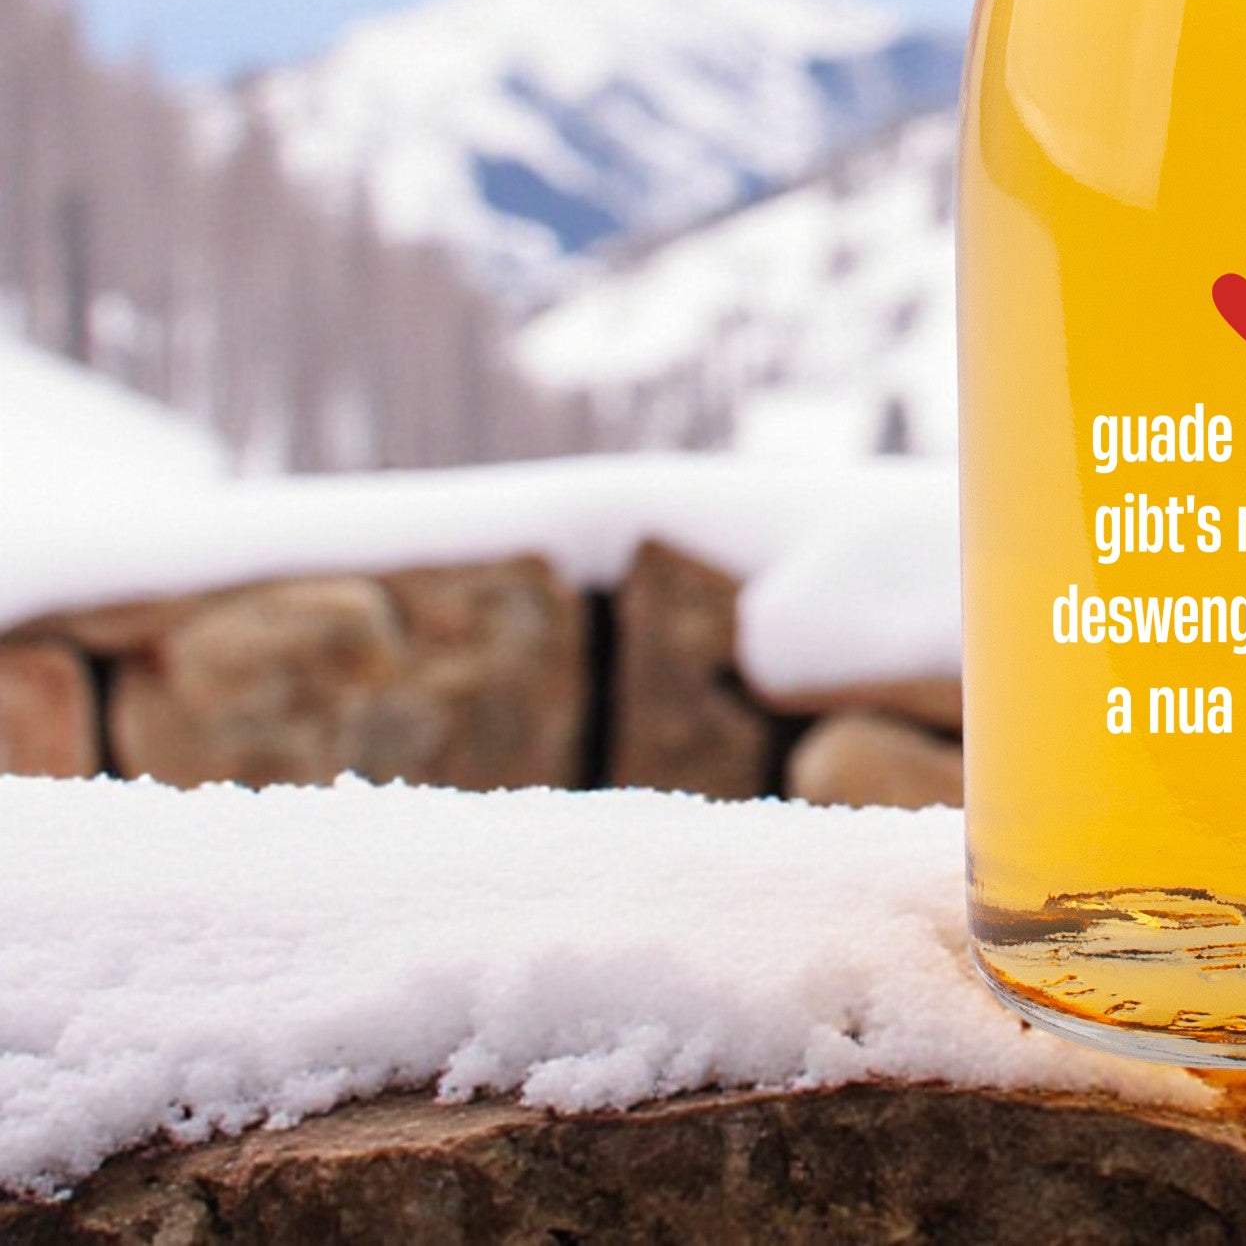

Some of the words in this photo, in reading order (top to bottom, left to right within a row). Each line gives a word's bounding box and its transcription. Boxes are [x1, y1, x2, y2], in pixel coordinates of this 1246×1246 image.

[1092, 403, 1232, 474] guade
[1094, 493, 1221, 564] gibt's
[1106, 687, 1132, 734] a
[1148, 687, 1232, 734] nua
